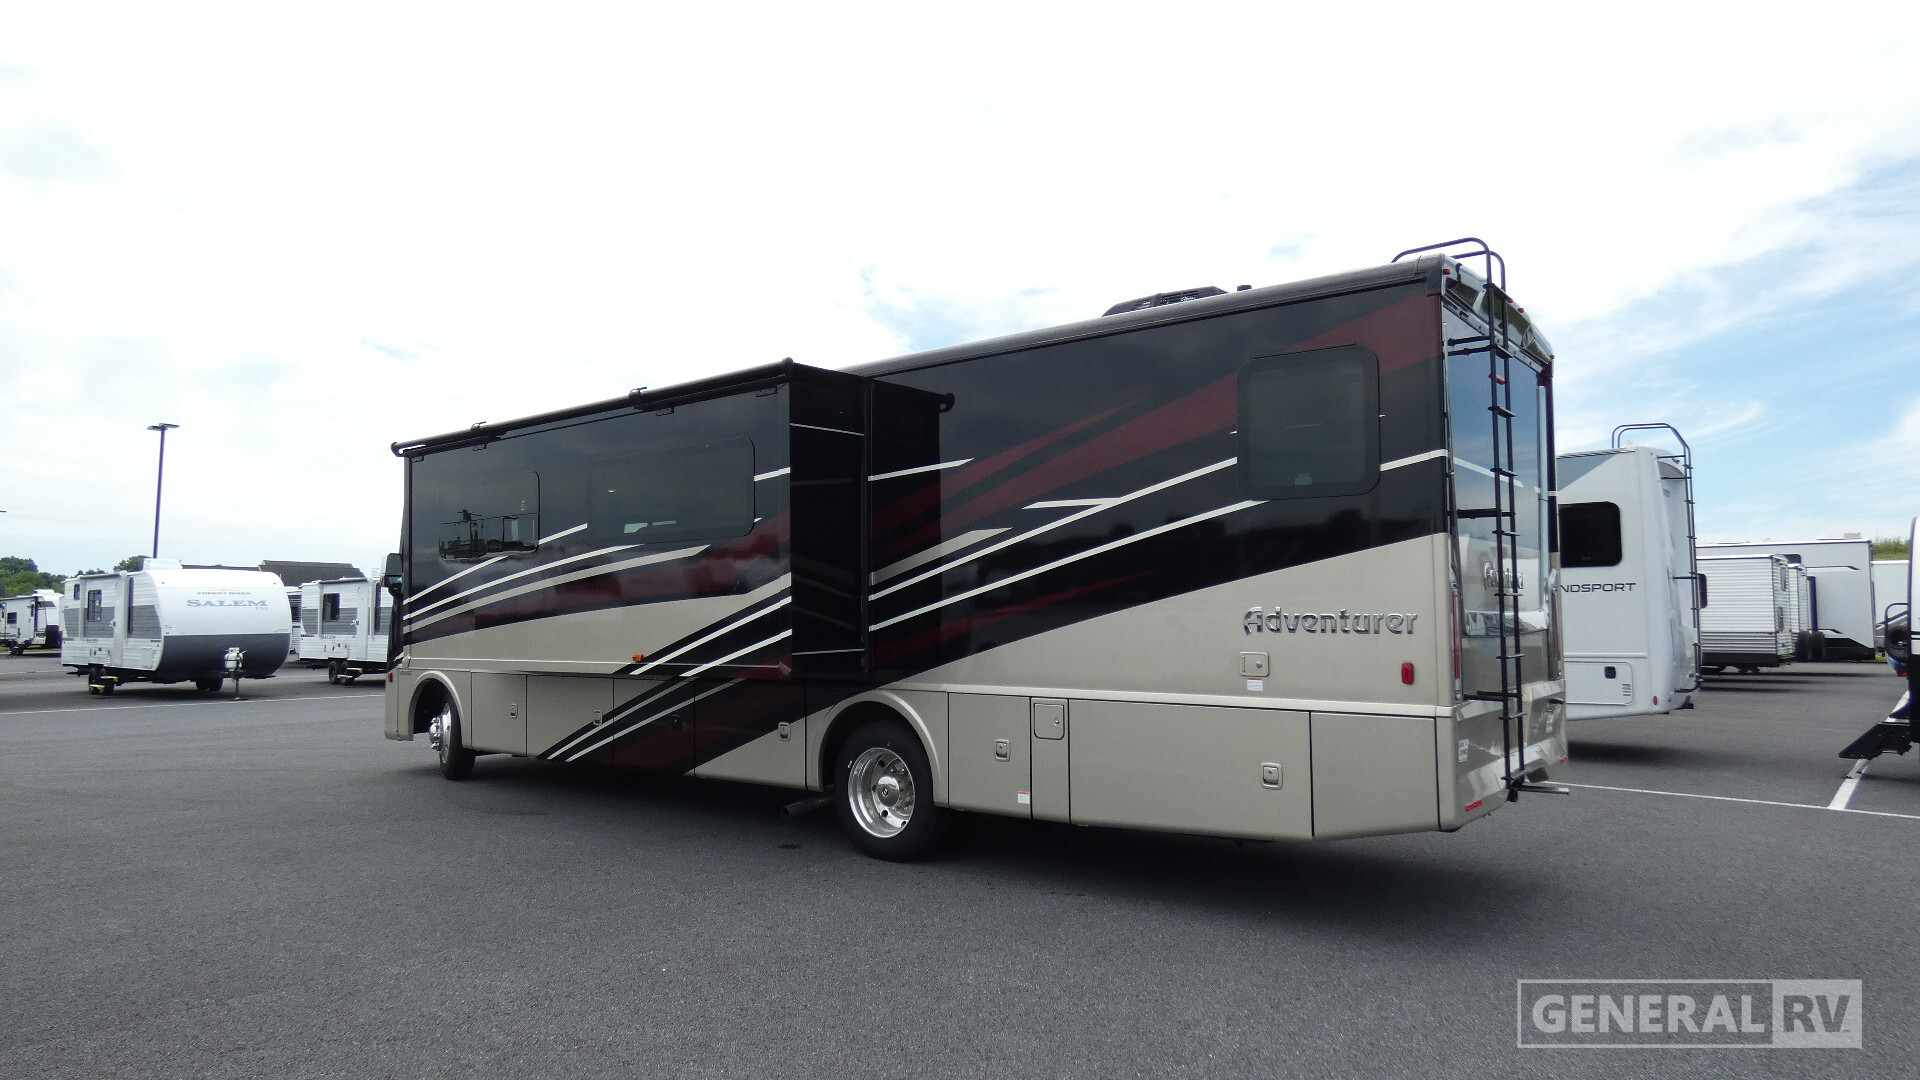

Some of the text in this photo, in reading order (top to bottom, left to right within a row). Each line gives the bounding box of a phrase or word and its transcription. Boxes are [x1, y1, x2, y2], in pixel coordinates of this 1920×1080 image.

[1560, 583, 1636, 593] NDSPORT
[187, 599, 268, 607] SALEM
[1243, 606, 1418, 636] Adventurer
